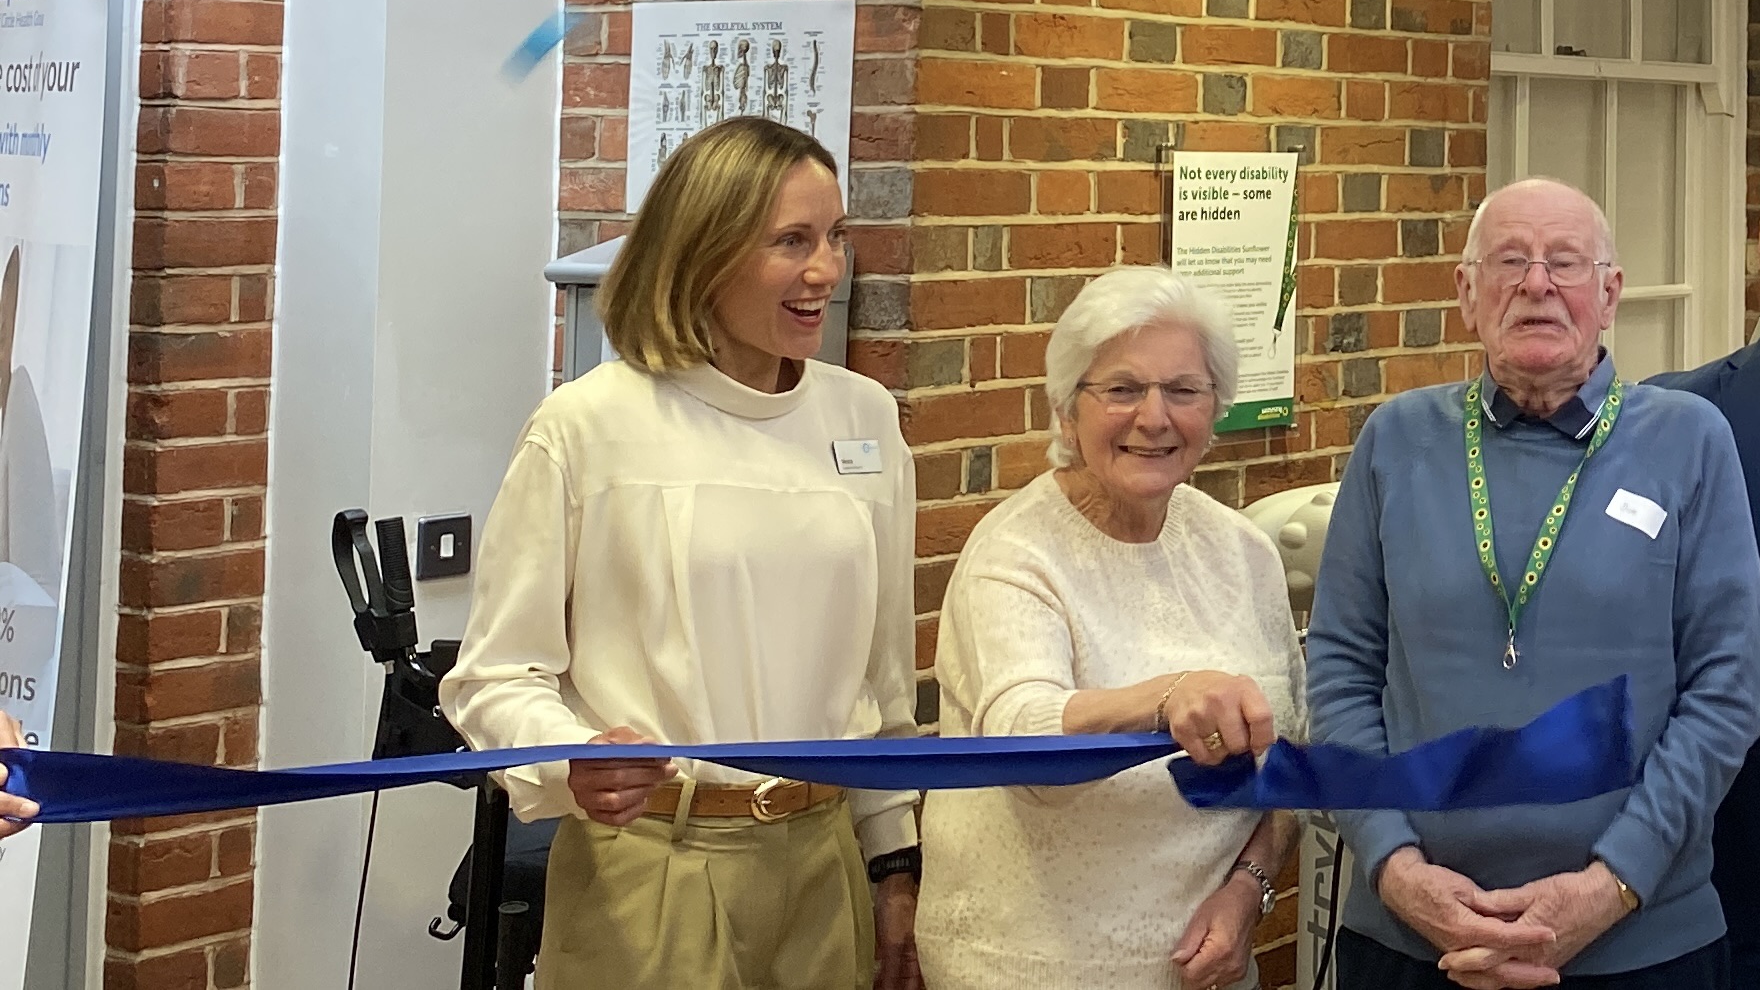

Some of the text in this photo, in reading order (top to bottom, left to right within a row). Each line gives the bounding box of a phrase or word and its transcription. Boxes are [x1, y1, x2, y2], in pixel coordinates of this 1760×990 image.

[696, 21, 783, 31] THE SKELETAL SYSTEM
[40, 61, 80, 102] your
[1180, 166, 1289, 183] Not every disability
[1179, 187, 1188, 200] is
[1191, 186, 1229, 200] visible
[1243, 189, 1272, 200] some
[1178, 207, 1240, 221] are hidden
[1177, 247, 1187, 255] The
